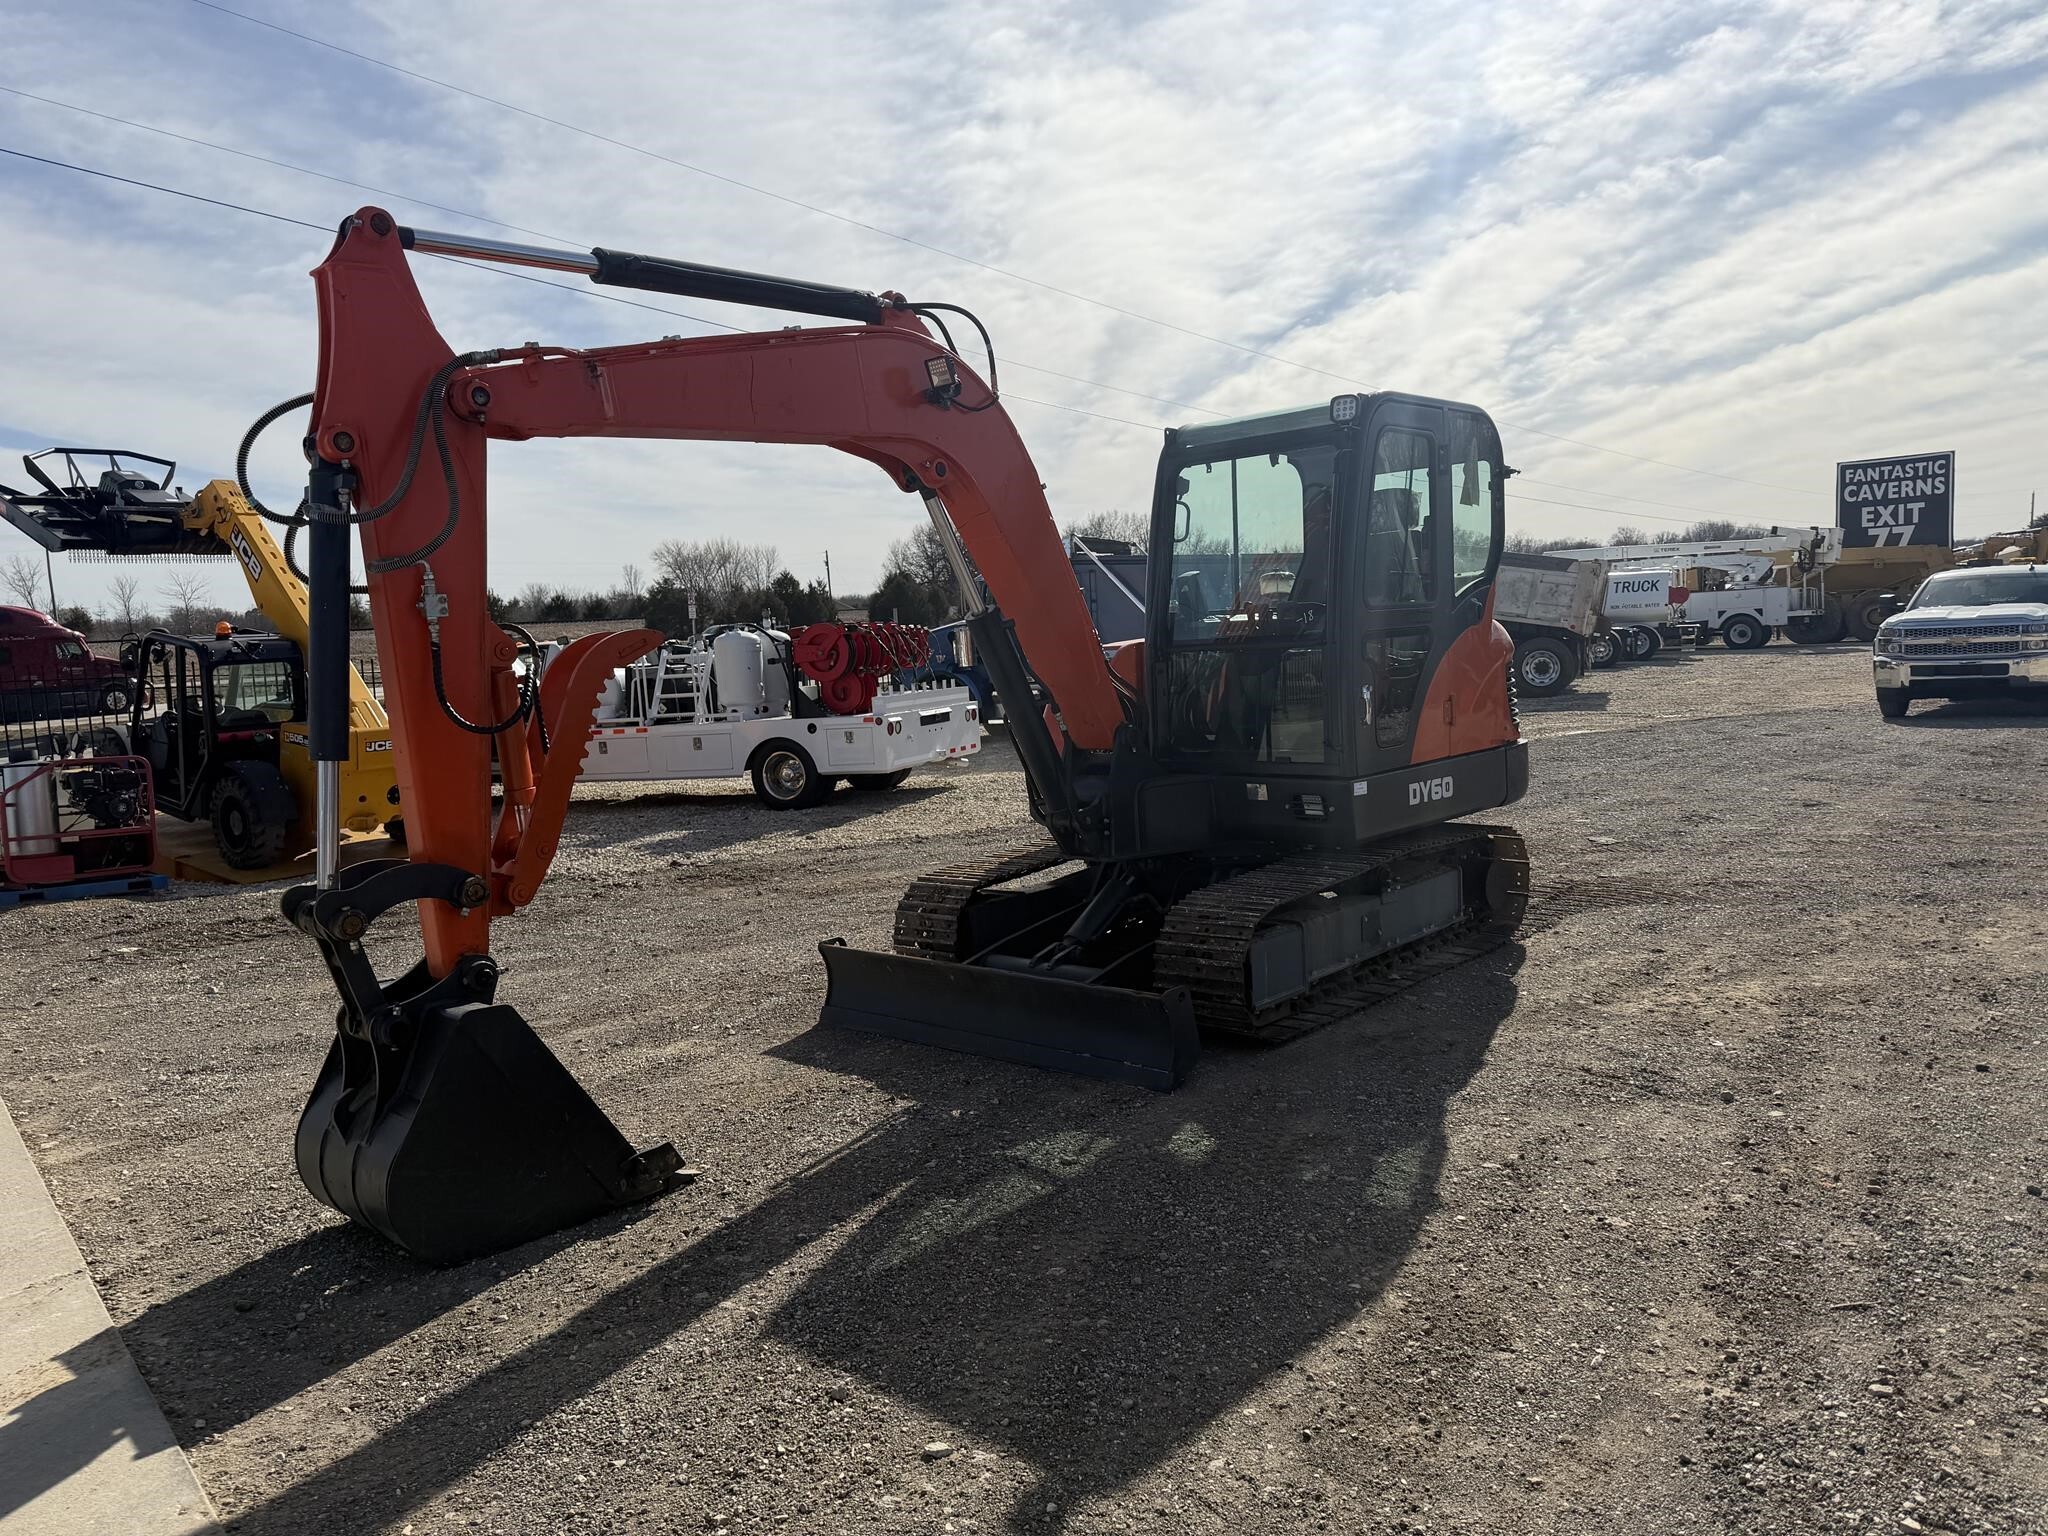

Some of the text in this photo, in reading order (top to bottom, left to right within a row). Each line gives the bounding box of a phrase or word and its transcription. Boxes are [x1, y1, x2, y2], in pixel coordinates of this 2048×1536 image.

[1845, 460, 1946, 483] FANTASTIC
[1843, 477, 1946, 502] CAVERNS
[1861, 502, 1926, 527] EXIT
[1868, 525, 1916, 547] 77
[231, 525, 262, 581] JCB
[1613, 580, 1660, 593] TRUCK
[1408, 775, 1454, 806] DY60
